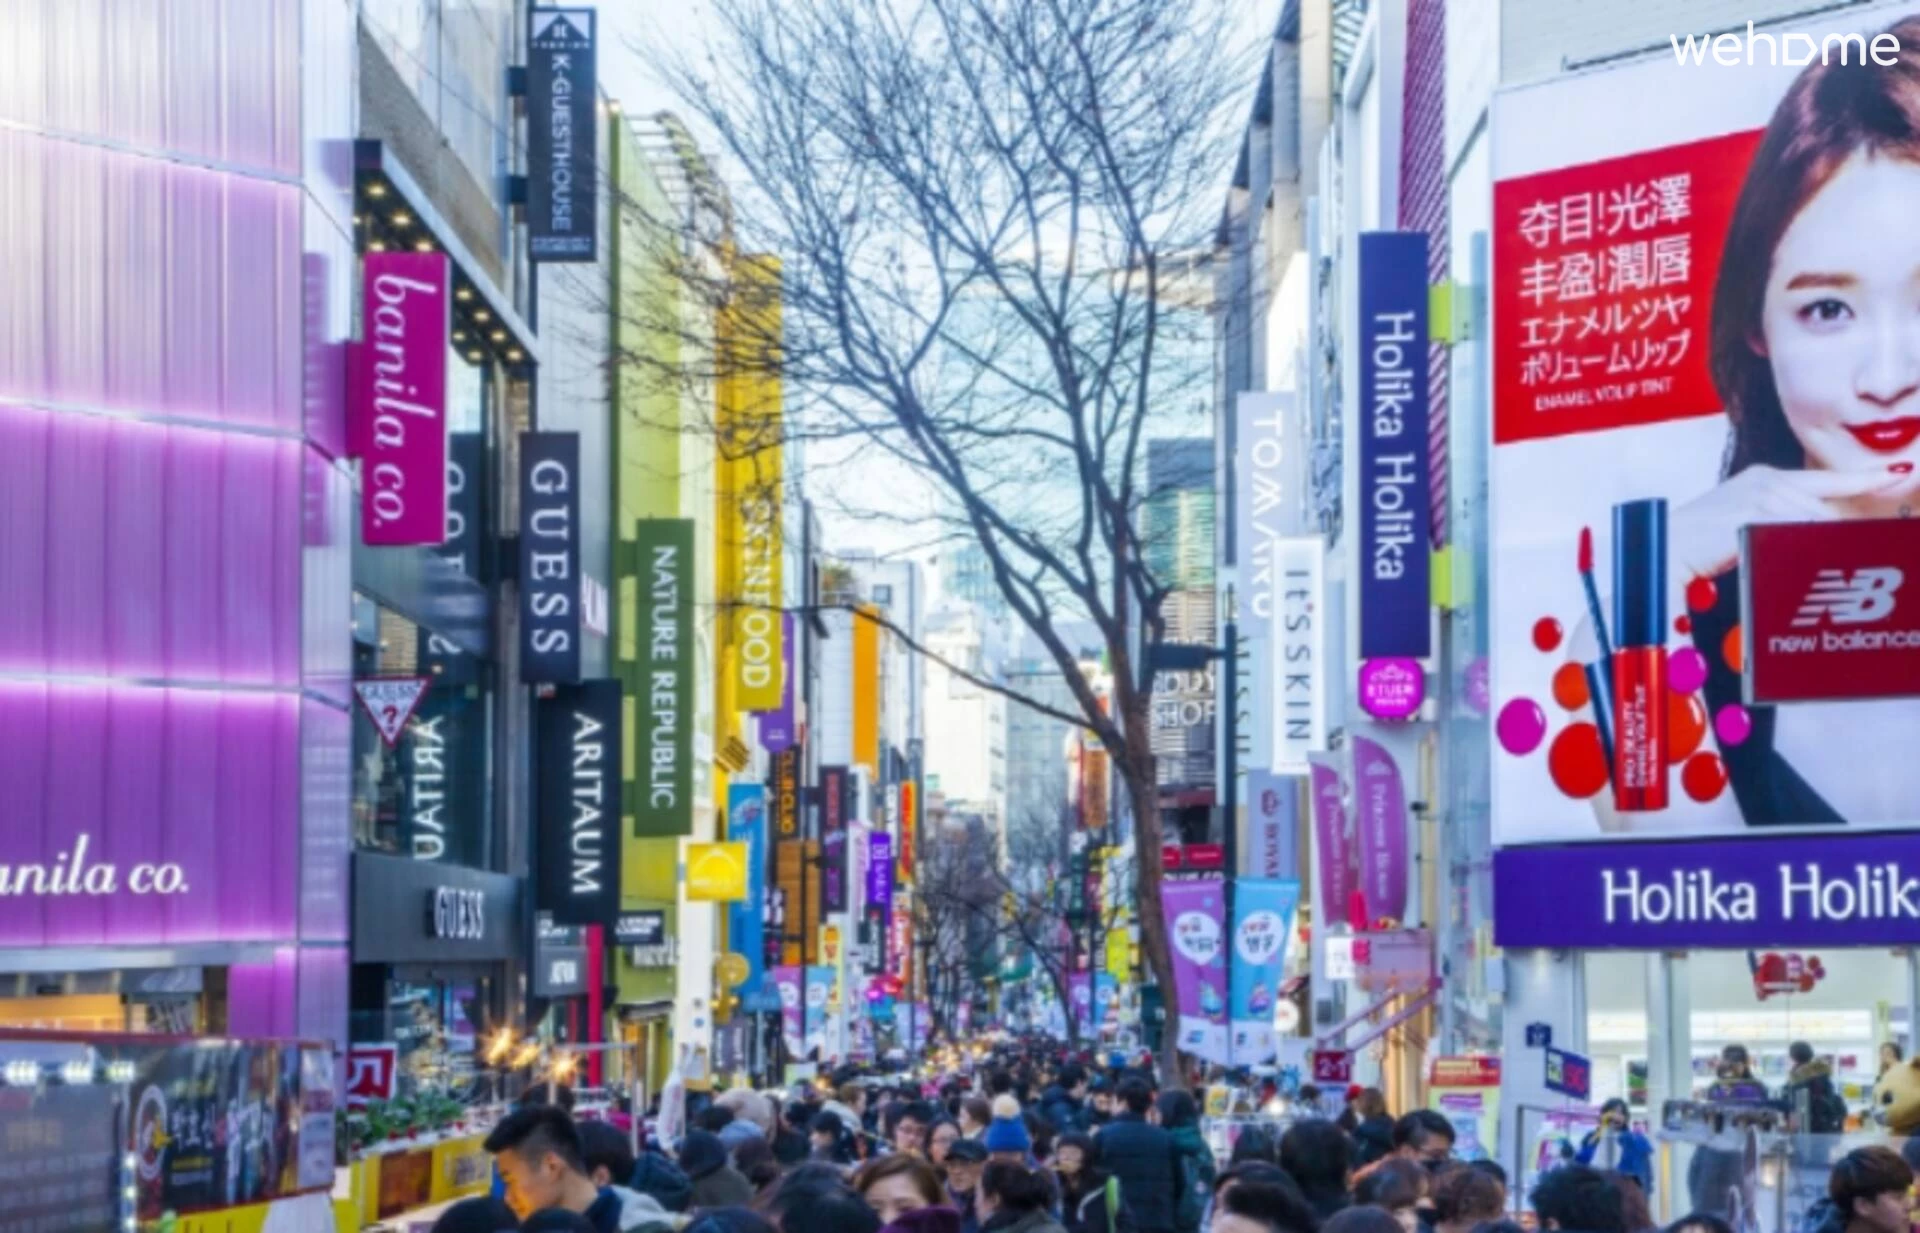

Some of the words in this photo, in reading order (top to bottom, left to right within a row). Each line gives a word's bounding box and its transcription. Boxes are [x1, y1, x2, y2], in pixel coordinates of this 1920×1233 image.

[552, 53, 572, 231] K-GUESTHOUSE
[373, 273, 438, 450] banila
[1373, 310, 1415, 437] Holika
[373, 462, 405, 528] co.
[530, 459, 569, 653] GUESS
[1374, 453, 1416, 580] Holika
[651, 545, 678, 660] NATURE
[1768, 633, 1818, 654] new
[571, 711, 604, 894] ARITAUM
[651, 671, 678, 809] REPUBLIC
[128, 863, 190, 895] co.
[434, 886, 484, 940] GUESS
[1601, 869, 1757, 924] Holika
[1778, 863, 1920, 921] Holik
